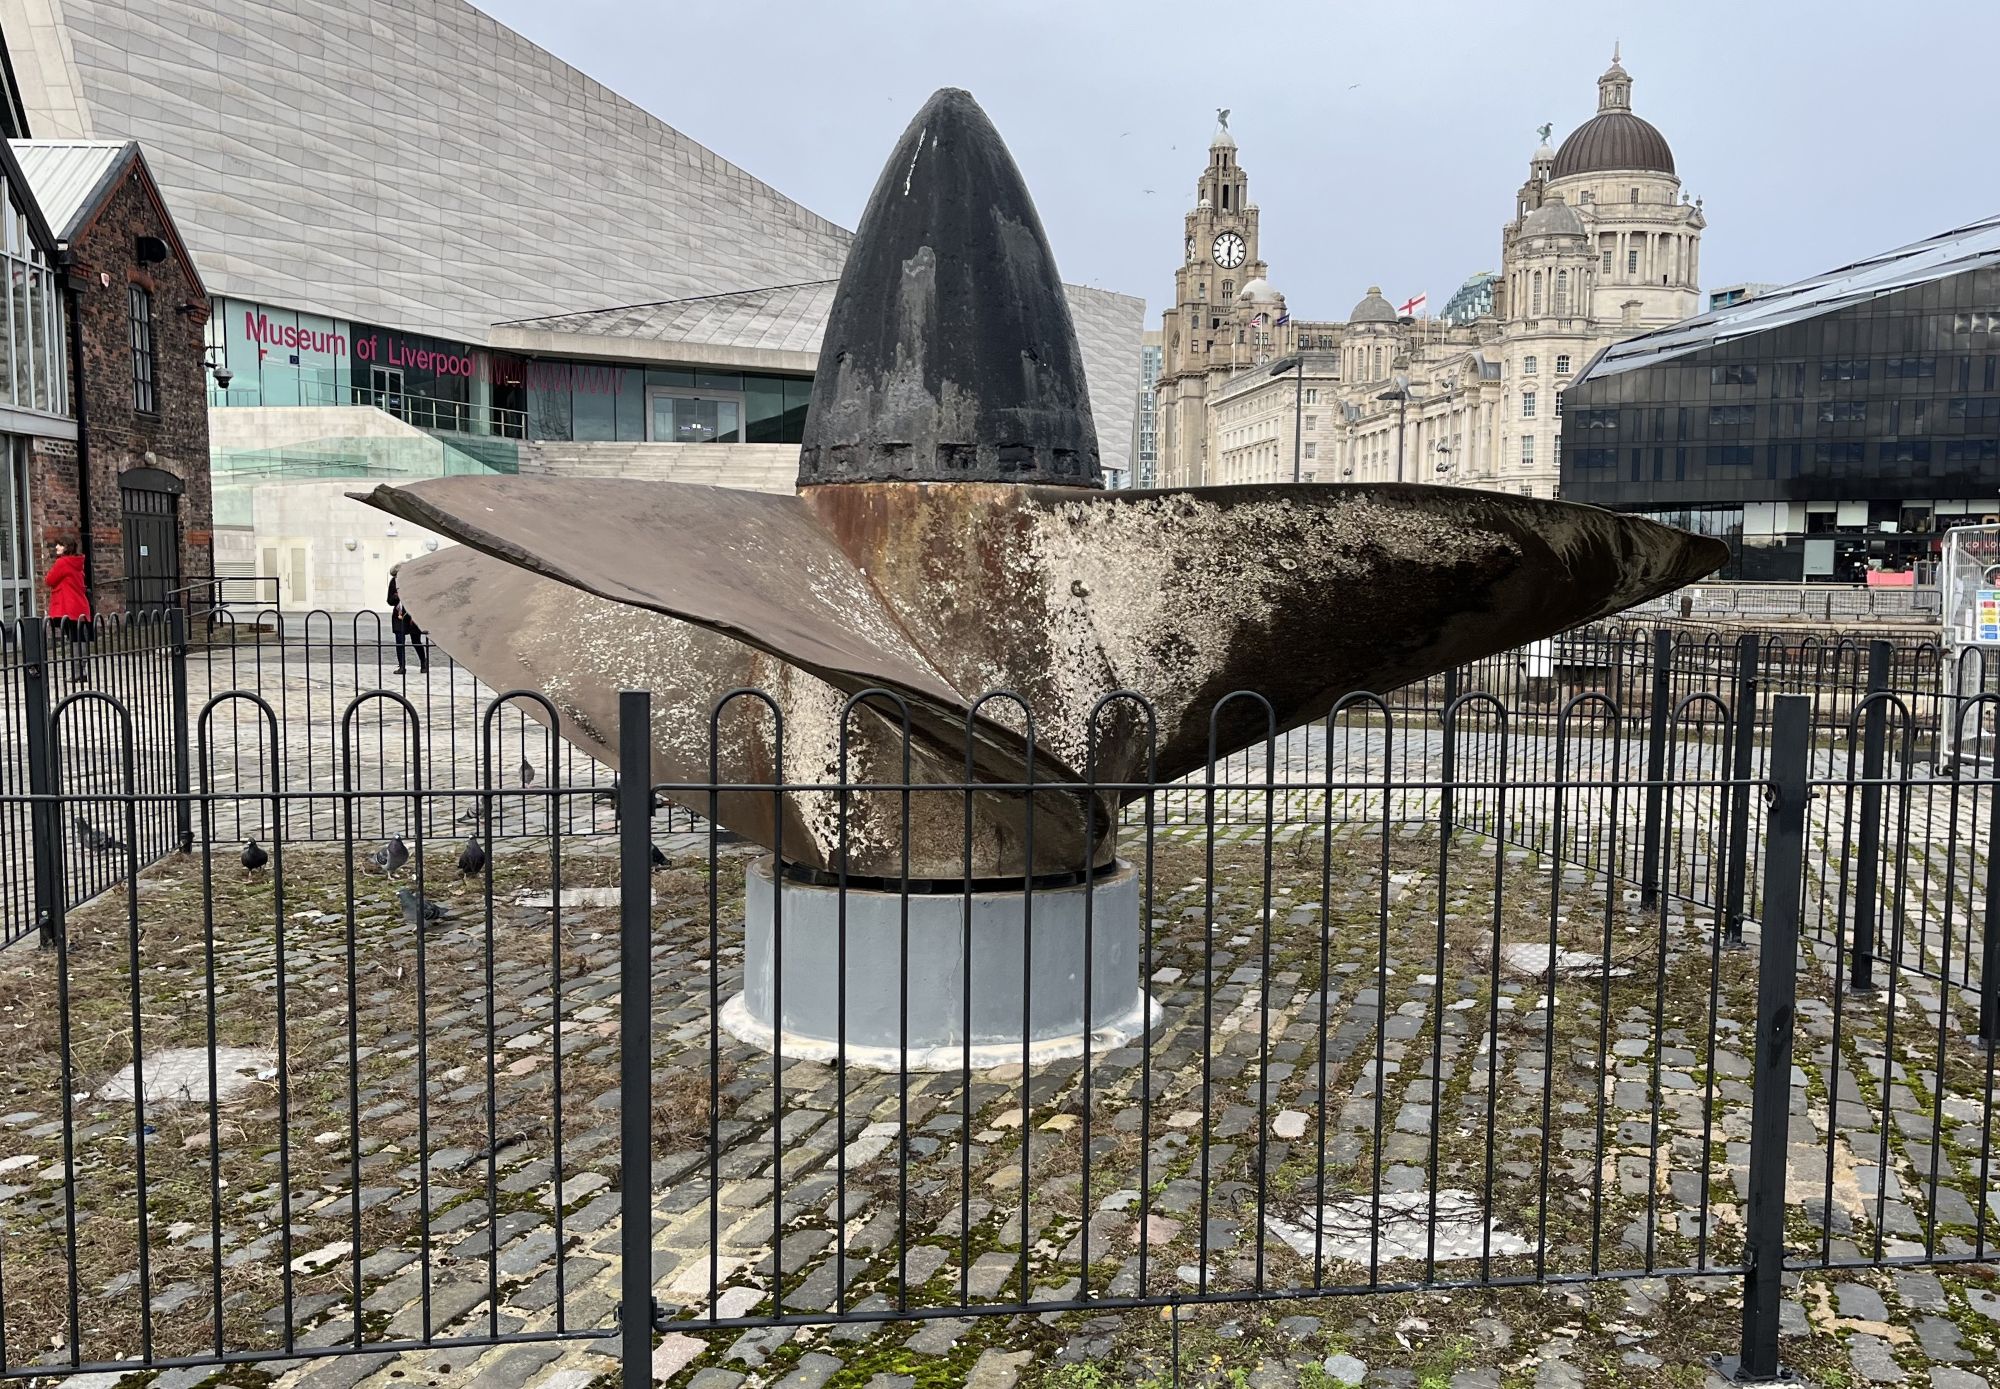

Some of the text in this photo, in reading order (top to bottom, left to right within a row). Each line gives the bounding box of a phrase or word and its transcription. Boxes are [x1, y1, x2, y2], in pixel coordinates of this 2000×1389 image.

[245, 311, 476, 378] Museum of Liverpool
